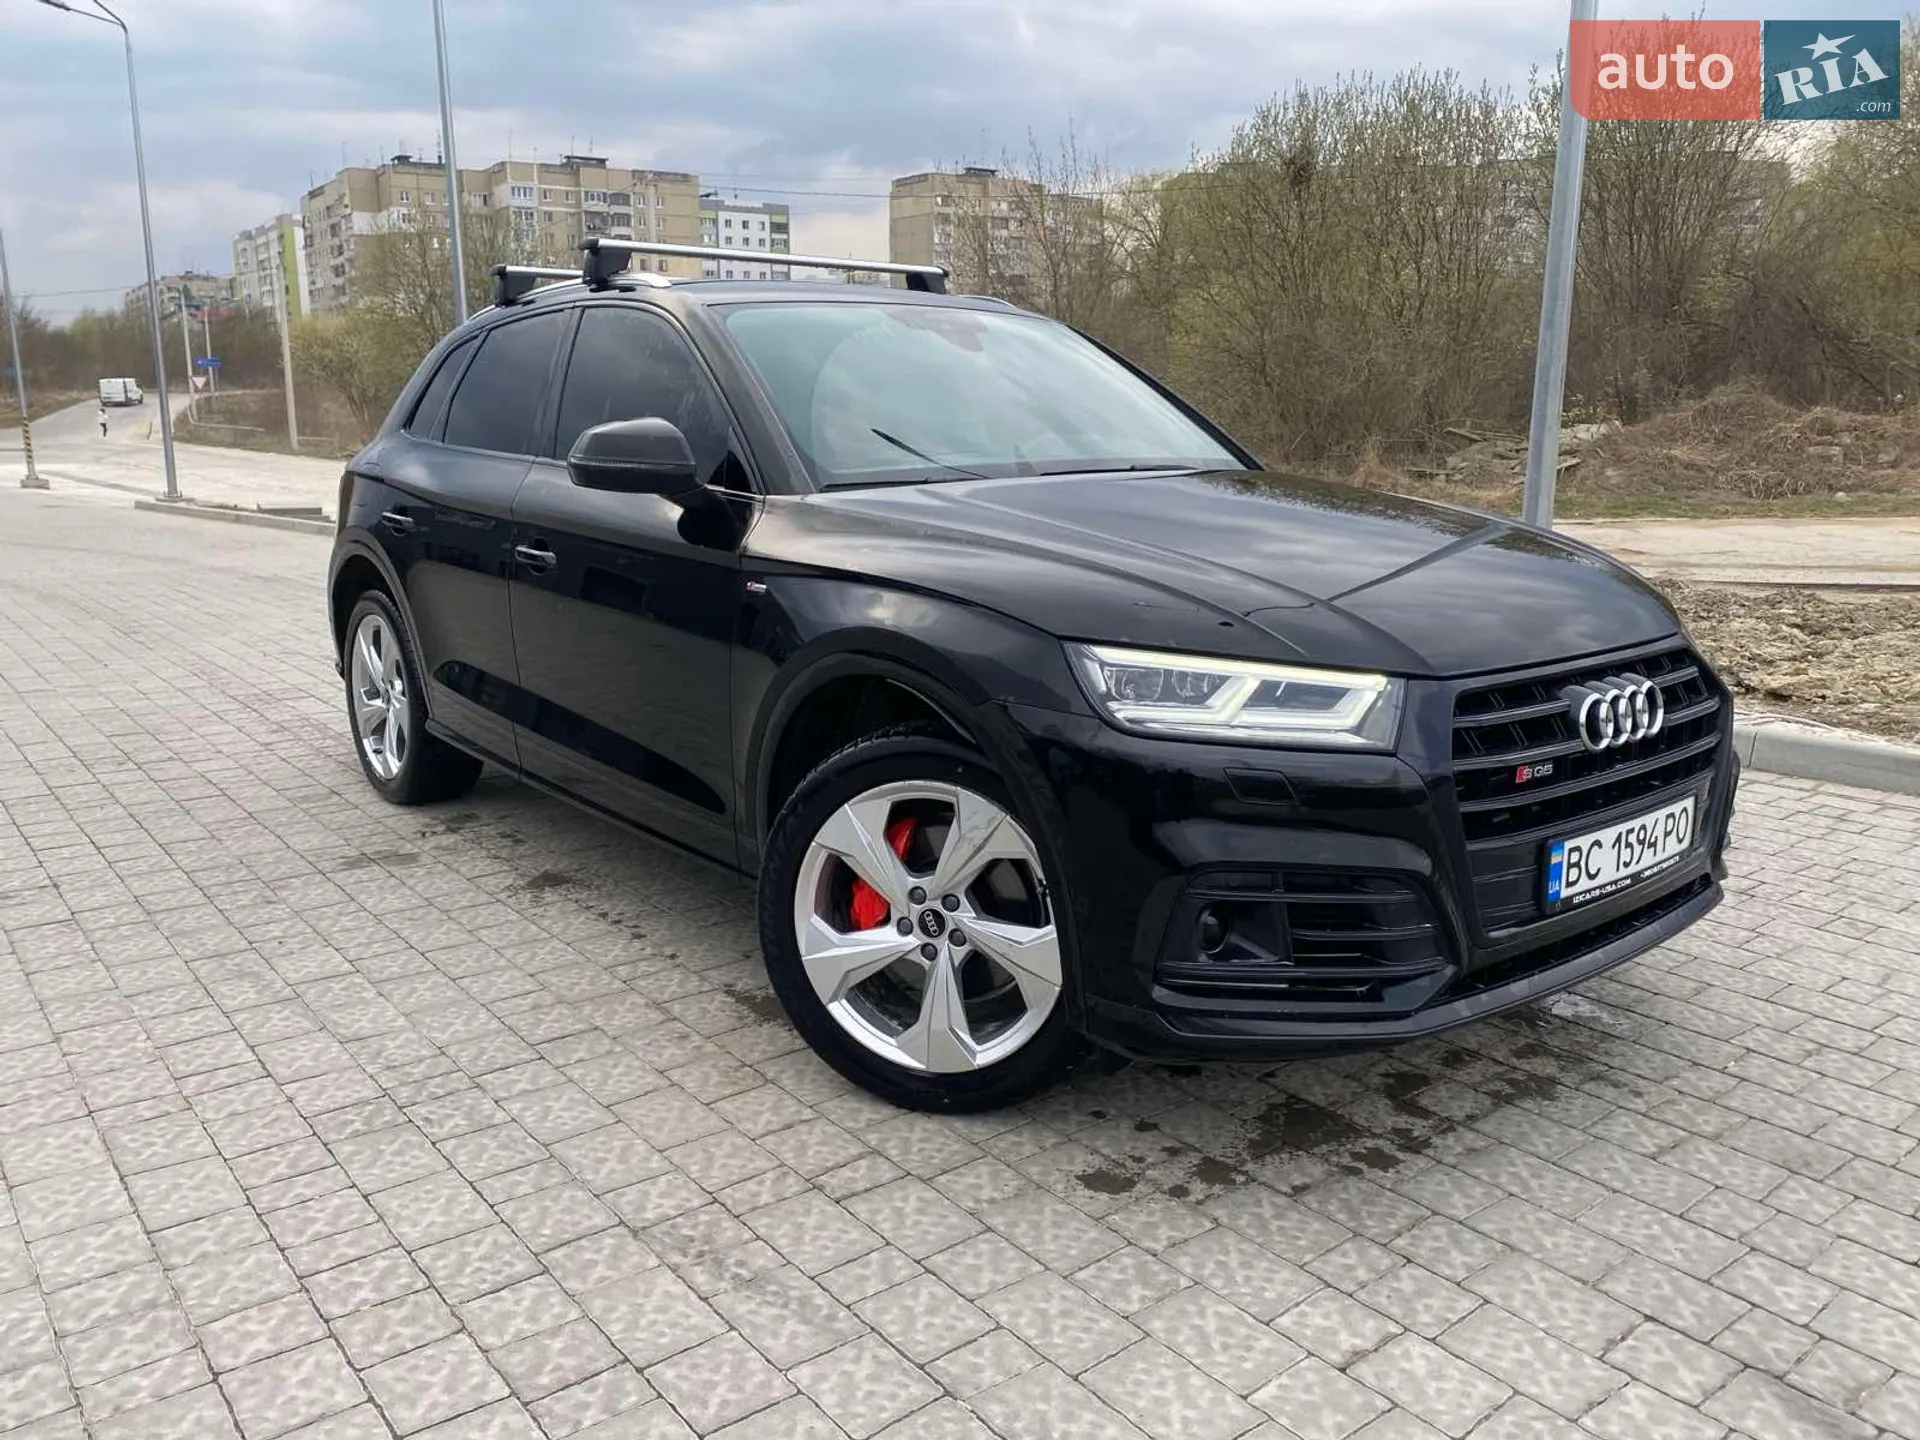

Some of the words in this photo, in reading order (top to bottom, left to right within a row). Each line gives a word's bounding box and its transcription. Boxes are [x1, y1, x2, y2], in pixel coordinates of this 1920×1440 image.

[1521, 764, 1554, 779] SQ5
[1565, 839, 1603, 888] BC
[1612, 818, 1660, 873] 1594
[1663, 806, 1689, 853] PO
[1548, 879, 1560, 894] UA
